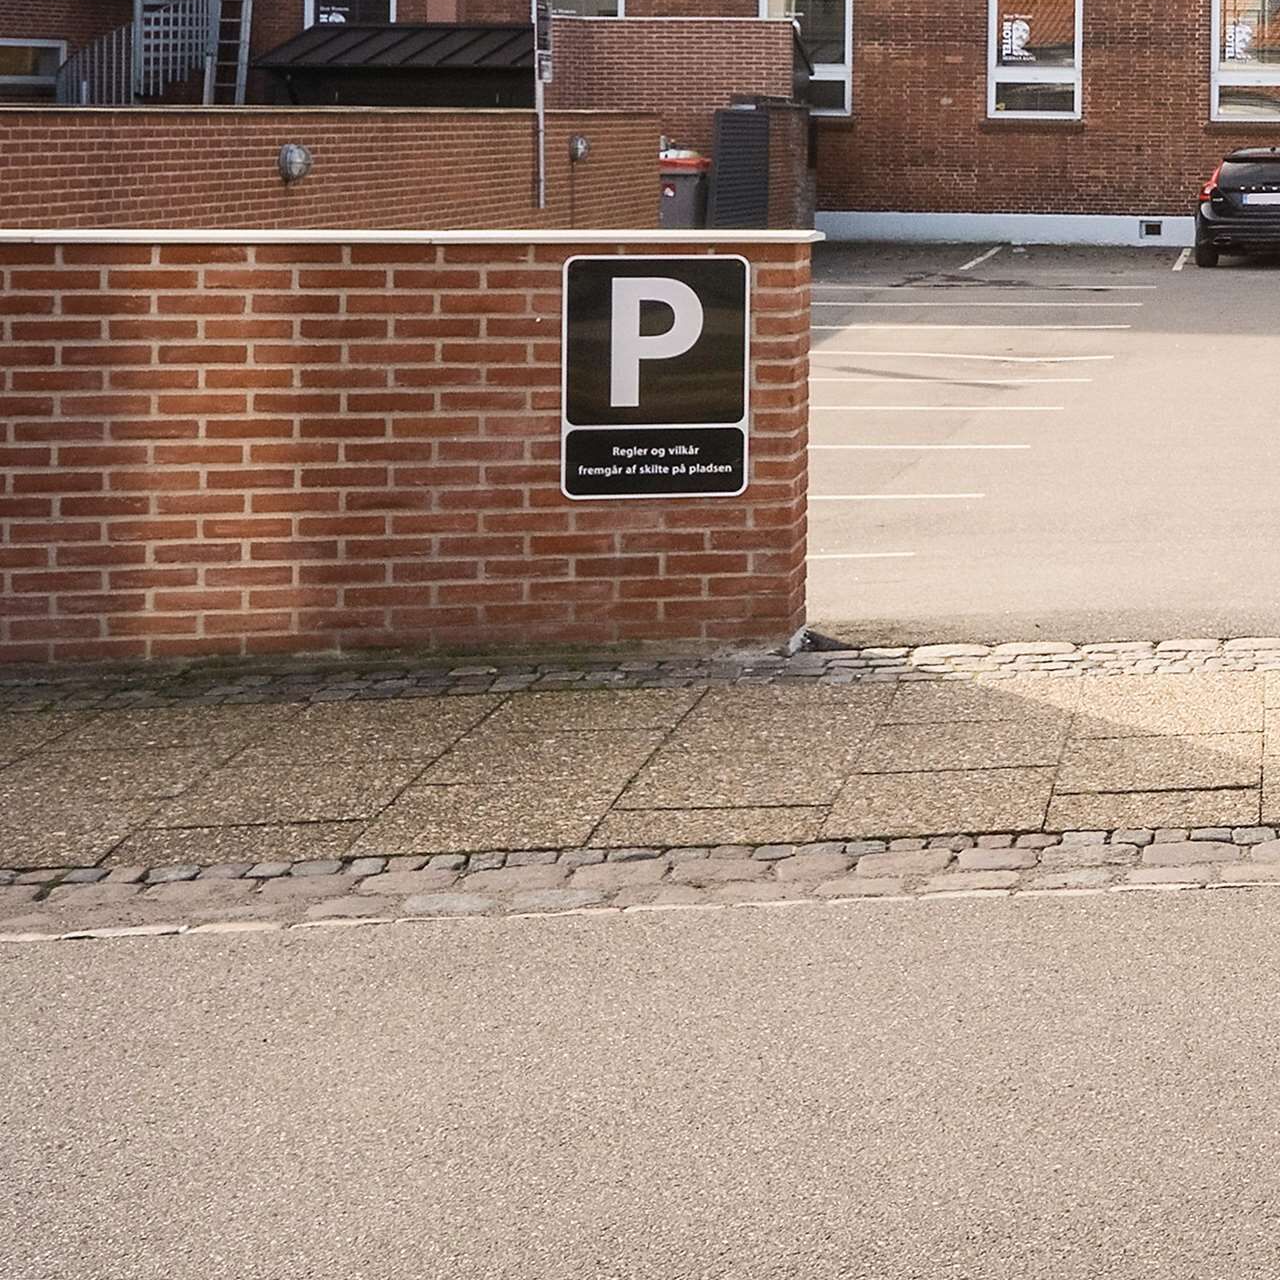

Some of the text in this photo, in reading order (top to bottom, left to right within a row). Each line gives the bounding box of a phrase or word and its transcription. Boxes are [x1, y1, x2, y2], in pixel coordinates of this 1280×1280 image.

[1003, 22, 1011, 56] HOTEL
[610, 277, 704, 408] P
[612, 445, 700, 458] Regler og vilkår
[578, 463, 733, 477] fremgår af skilte på pladsen
